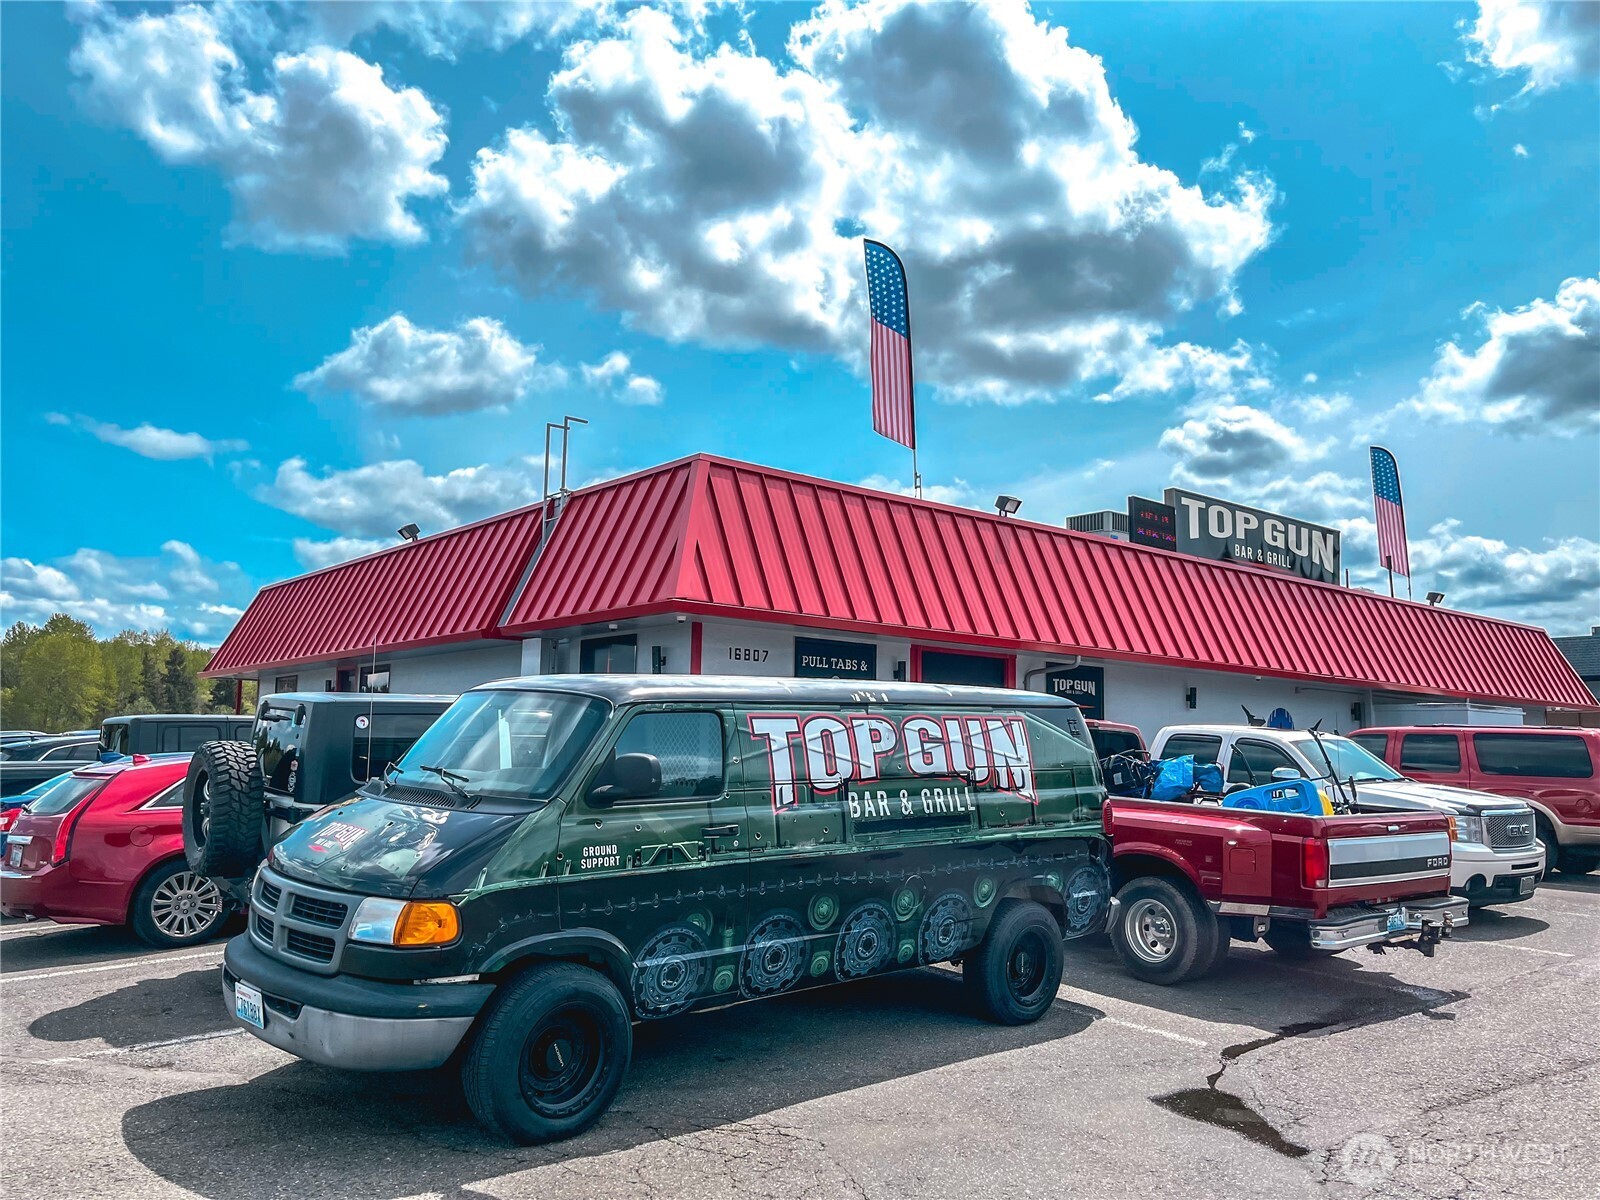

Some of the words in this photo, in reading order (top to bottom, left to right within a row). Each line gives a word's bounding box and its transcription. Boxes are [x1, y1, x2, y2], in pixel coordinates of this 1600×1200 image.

[1181, 497, 1259, 540] TOP
[1263, 518, 1334, 574] GUN
[1234, 543, 1253, 560] BAR
[1257, 548, 1264, 562] &
[1267, 550, 1292, 569] GRILL
[728, 646, 769, 663] 16807
[802, 655, 829, 669] PULL
[831, 657, 858, 671] TABS
[860, 660, 868, 672] &
[1052, 678, 1073, 693] TOP
[1074, 679, 1096, 697] GUN
[748, 714, 898, 812] TOP
[900, 715, 1038, 803] GUN
[849, 790, 891, 818] BAR
[901, 789, 914, 816] &
[921, 786, 976, 815] GRILL
[582, 844, 618, 857] GROUND
[580, 855, 621, 869] SUPPORT
[1426, 856, 1449, 868] FORD
